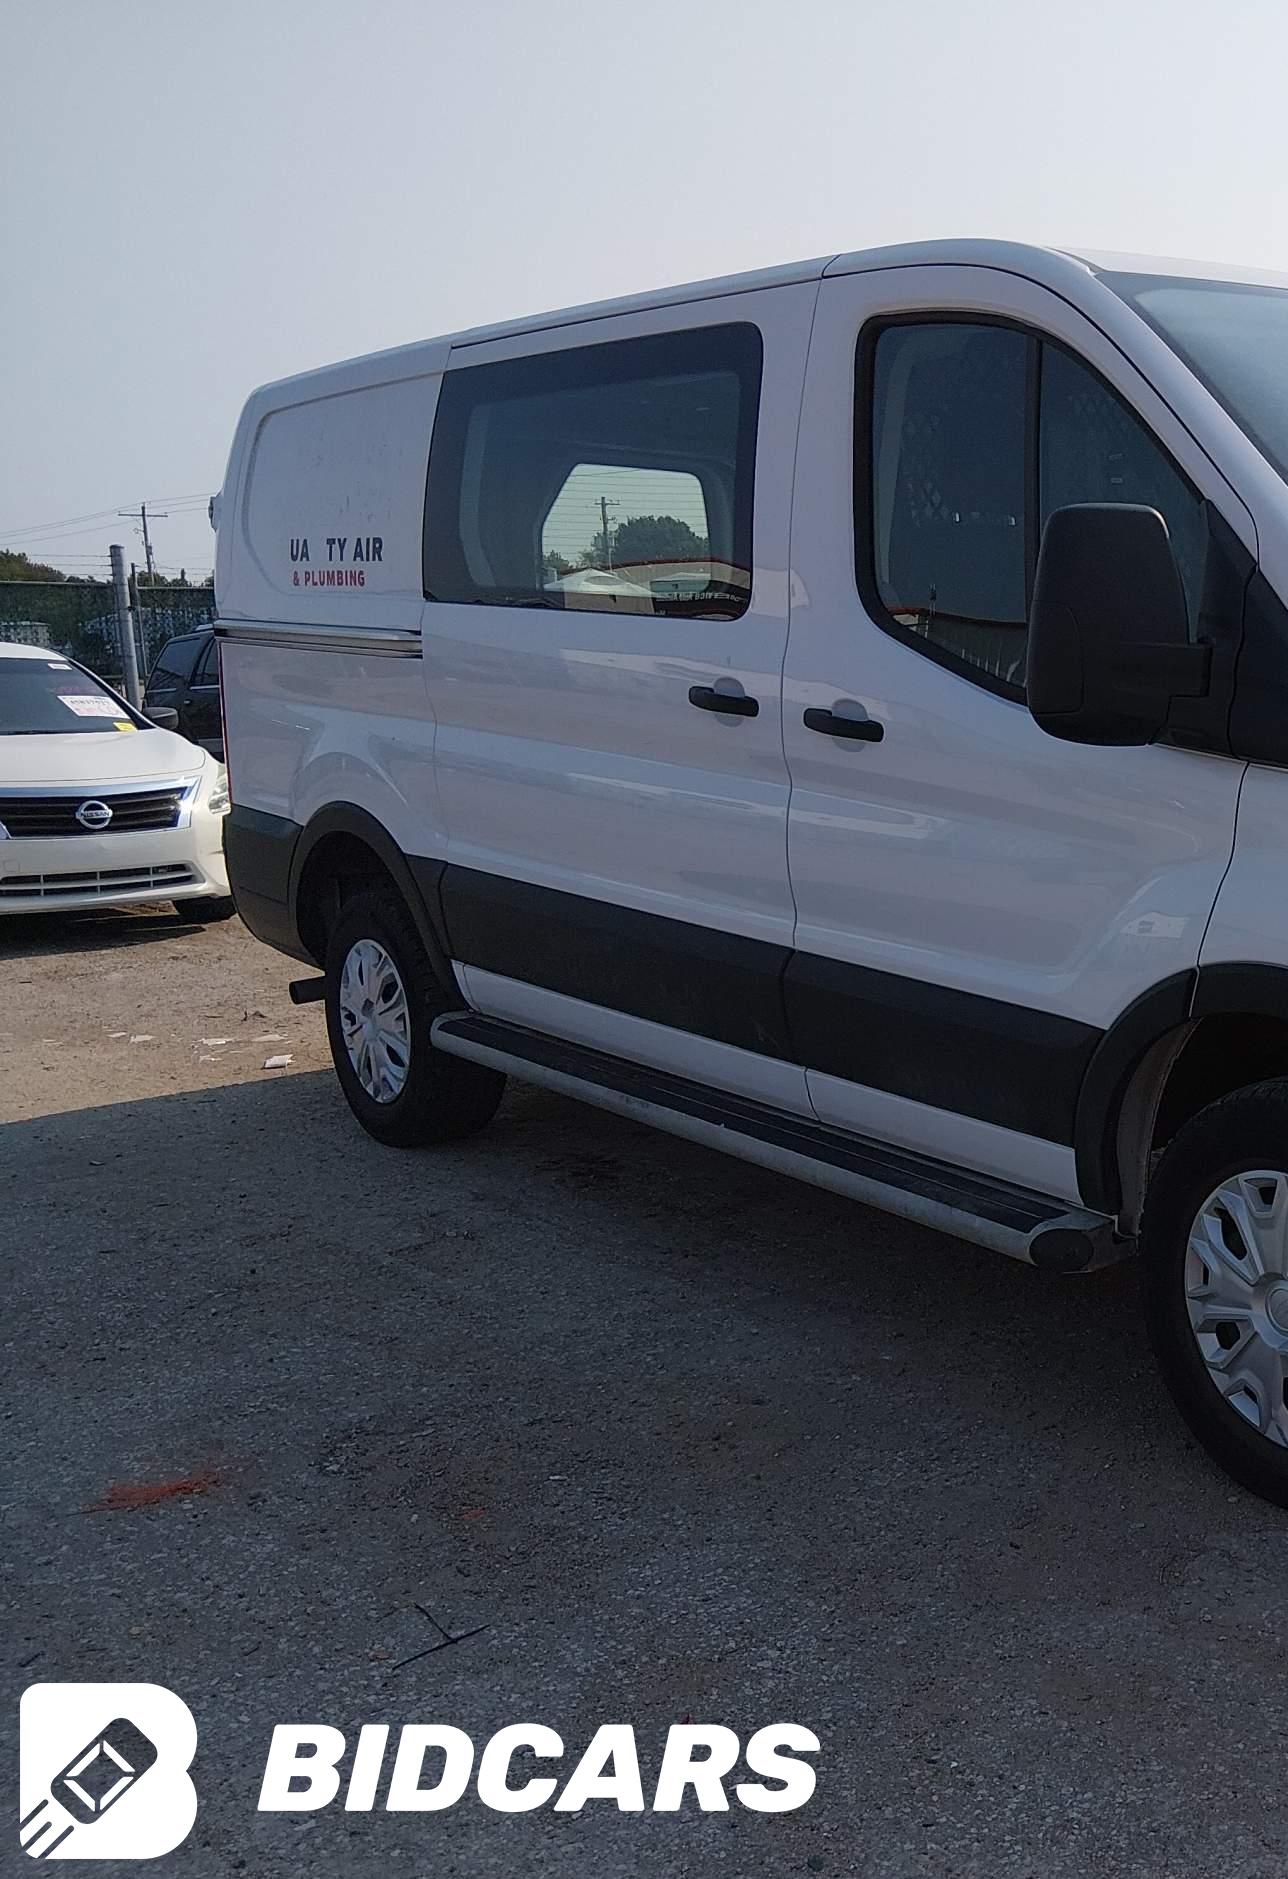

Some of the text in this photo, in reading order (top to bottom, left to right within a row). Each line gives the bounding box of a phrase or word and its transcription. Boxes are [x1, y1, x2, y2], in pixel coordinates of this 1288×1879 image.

[326, 537, 347, 562] TY
[353, 537, 383, 562] AIR
[293, 570, 365, 587] & PLUMBING
